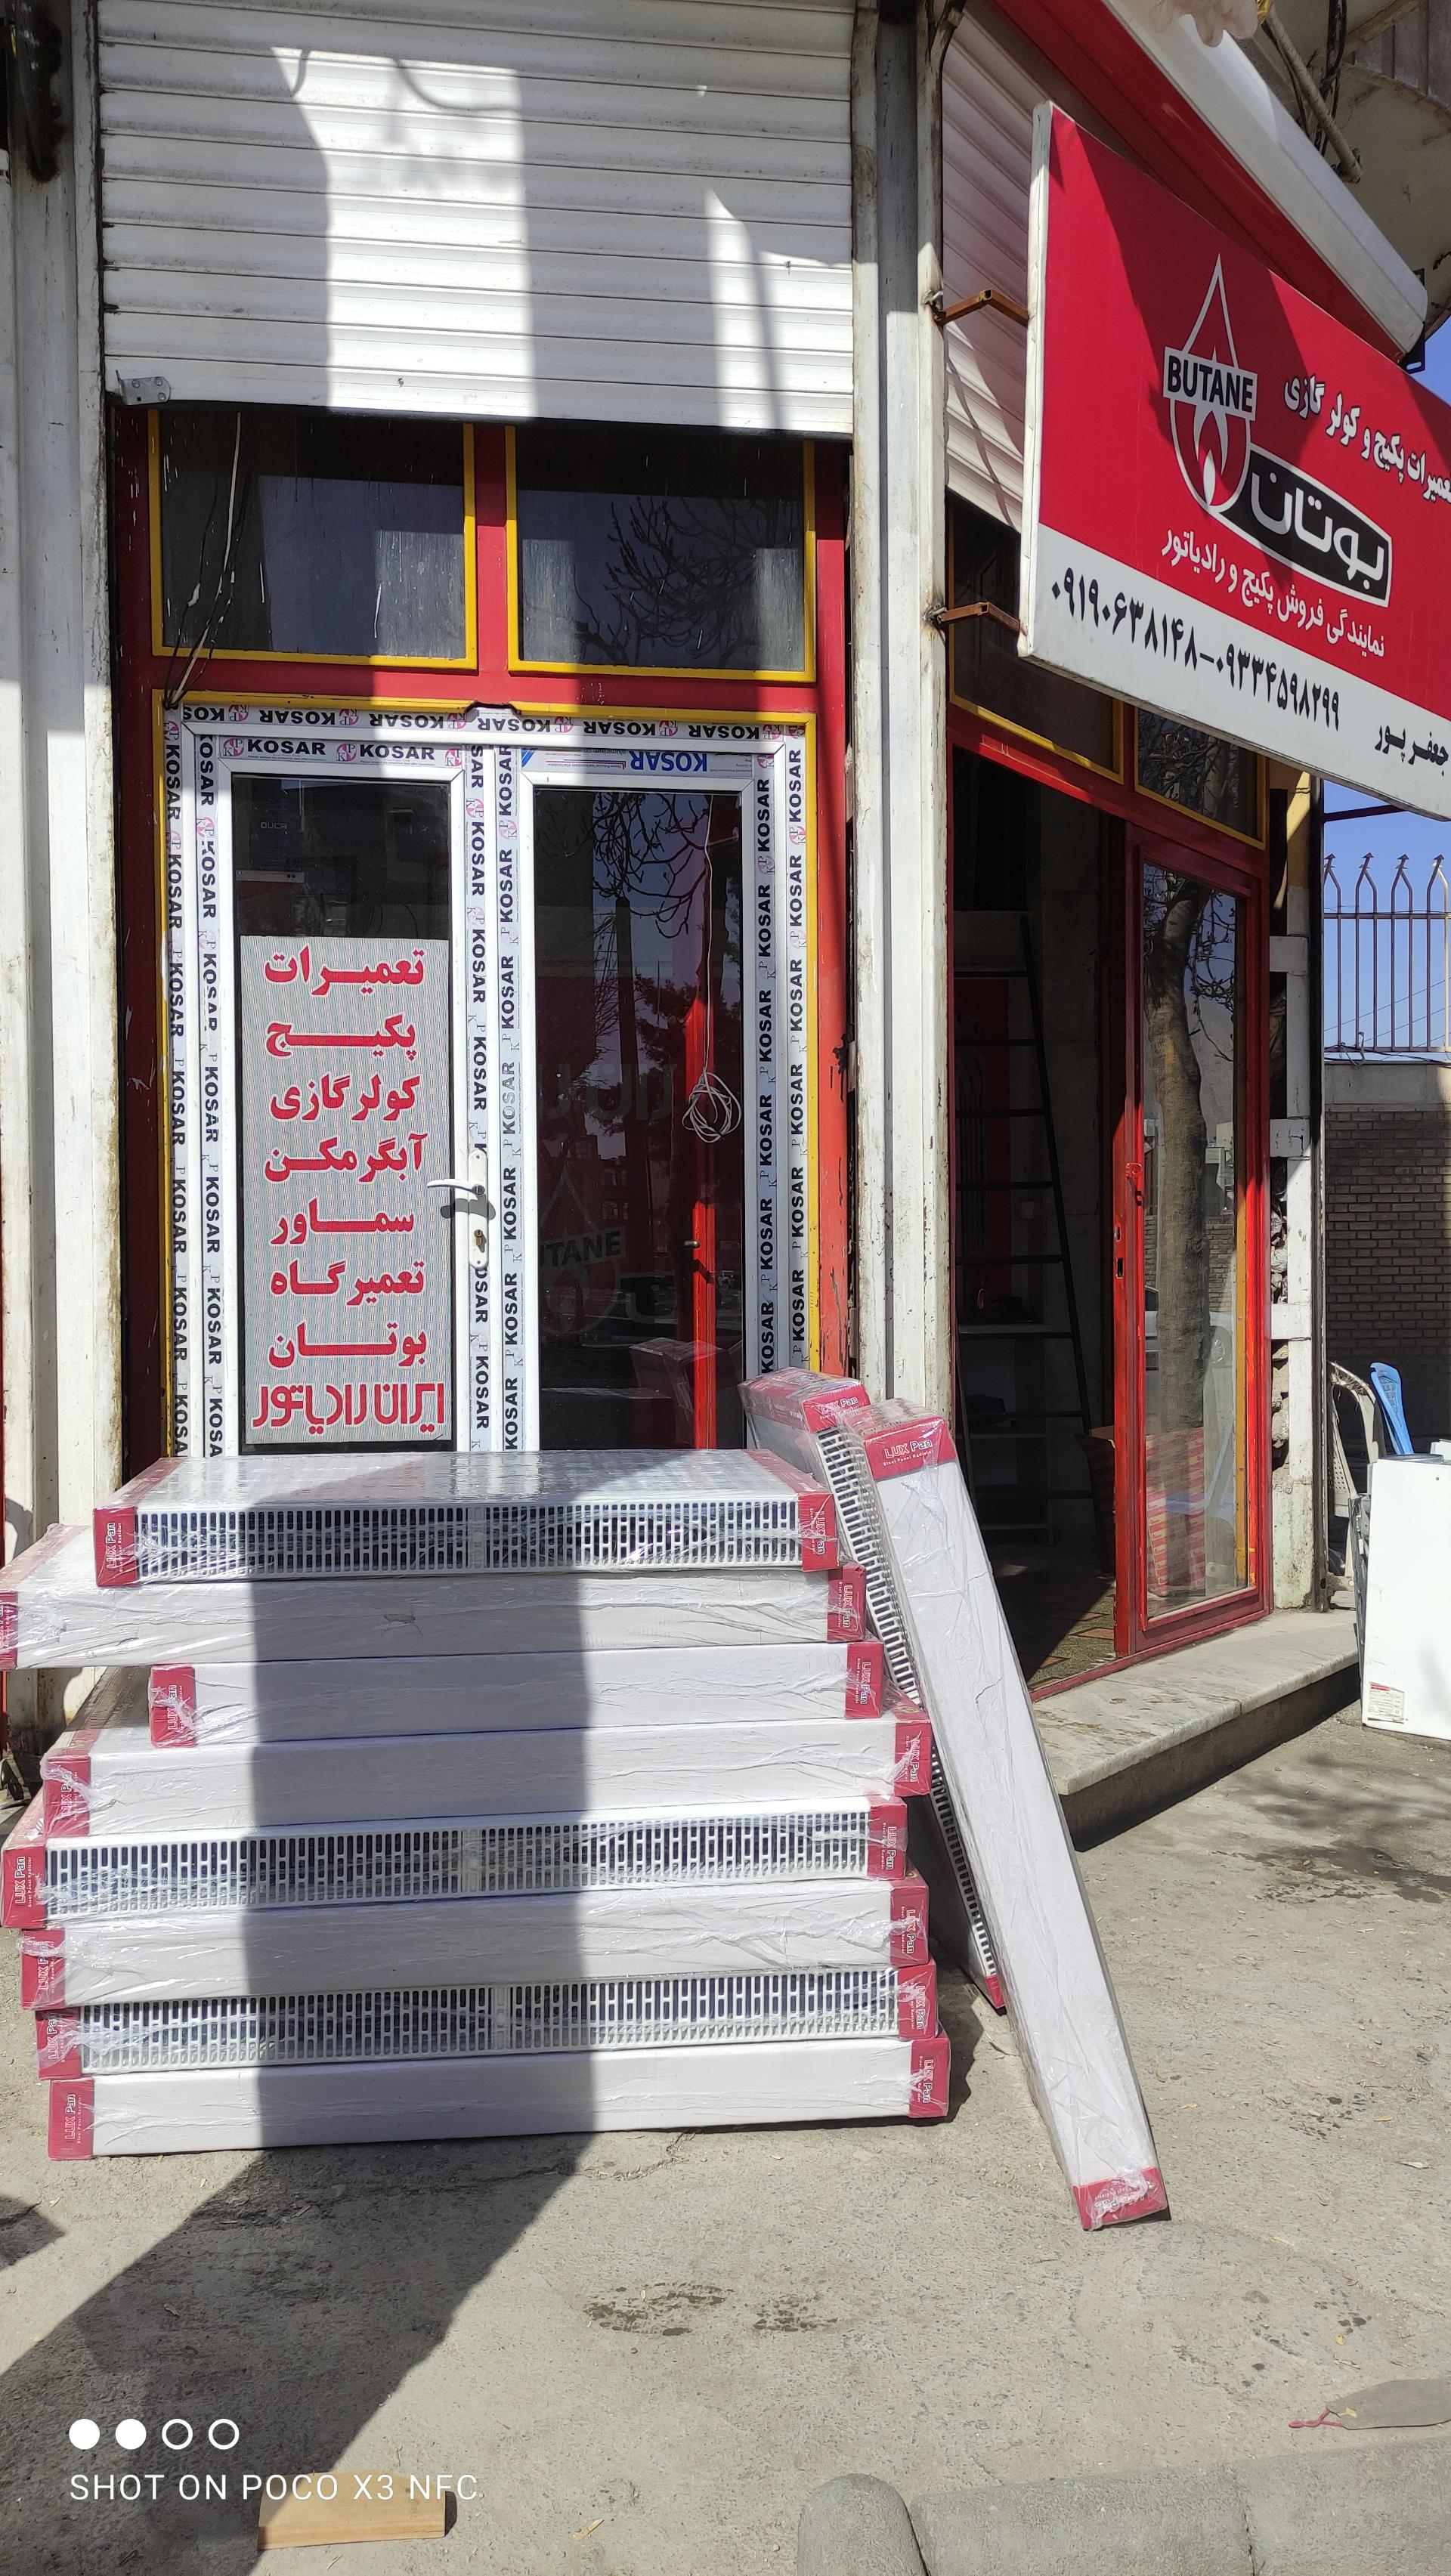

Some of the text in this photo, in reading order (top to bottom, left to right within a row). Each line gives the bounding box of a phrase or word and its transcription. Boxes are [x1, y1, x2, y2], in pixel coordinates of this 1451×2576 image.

[1166, 354, 1255, 415] BUTANE
[1284, 375, 1451, 504] عمیرات پکیج و کولر گازی
[1250, 470, 1385, 590] بوتان
[1161, 529, 1384, 657] نمایندگی فروش پکیج و رادیاتور
[248, 738, 326, 756] KOSAR
[259, 709, 336, 725] KOSAR
[369, 713, 444, 730] KOSAR
[477, 716, 552, 733] KOSAR
[583, 719, 656, 736] KOSAR
[688, 723, 760, 740] KOSAR
[166, 744, 181, 821] KOSAR
[360, 744, 435, 761] KOSAR
[630, 751, 707, 772] KOSAR
[788, 750, 801, 821] KOSAR
[756, 778, 770, 852] KOSAR
[168, 854, 183, 929] KOSAR
[201, 840, 216, 918] KOSAR
[472, 821, 485, 895] KOSAR
[500, 849, 513, 922] KOSAR
[789, 855, 802, 926] KOSAR
[756, 884, 770, 957] KOSAR
[168, 963, 184, 1038] KOSAR
[203, 954, 218, 1030] KOSAR
[264, 945, 425, 996] تعمیرات
[472, 929, 485, 1002] KOSAR
[500, 956, 514, 1028] KOSAR
[789, 960, 803, 1031] KOSAR
[265, 1014, 416, 1059] پکیج
[759, 989, 772, 1062] KOSAR
[169, 1070, 186, 1146] KOSAR
[205, 1066, 218, 1141] KOSAR
[270, 1073, 420, 1121] کولر گازی
[473, 1037, 487, 1109] KOSAR
[502, 1061, 515, 1135] KOSAR
[790, 1064, 803, 1134] KOSAR
[760, 1093, 772, 1166] KOSAR
[171, 1180, 187, 1254] KOSAR
[206, 1177, 219, 1252] KOSAR
[270, 1198, 415, 1245] سماور
[503, 1167, 517, 1239] KOSAR
[760, 1198, 773, 1270] KOSAR
[790, 1167, 803, 1237] KOSAR
[269, 1260, 425, 1307] تعمیرگاه
[475, 1266, 488, 1322] OSAR
[504, 1273, 518, 1344] KOSAR
[792, 1269, 805, 1341] KOSAR
[172, 1287, 187, 1361] KOSAR
[208, 1288, 221, 1364] KOSAR
[268, 1321, 427, 1368] بوتان
[760, 1300, 775, 1374] KOSAR
[174, 1394, 188, 1458] KOSA
[252, 1382, 444, 1435] ایران رادیاتور
[475, 1356, 489, 1428] KOSAR
[505, 1378, 518, 1449] KOSAR
[840, 1396, 859, 1409] Pan
[883, 1438, 933, 1459] LUX Pan
[106, 1523, 116, 1568] LUX Pan
[843, 1585, 853, 1607] LUX
[861, 1662, 871, 1704] LUX Pan
[167, 1707, 178, 1730] LUX
[910, 1762, 919, 1782] Pan
[14, 1856, 26, 1903] LUX Pan
[886, 1826, 897, 1869] LUX Pan
[38, 1965, 49, 1990] LUX
[907, 1934, 916, 1953] Pan
[48, 2036, 59, 2059] LUX
[916, 2009, 926, 2029] Pan
[65, 2094, 76, 2139] LUX Pan
[924, 2083, 933, 2103] Pan
